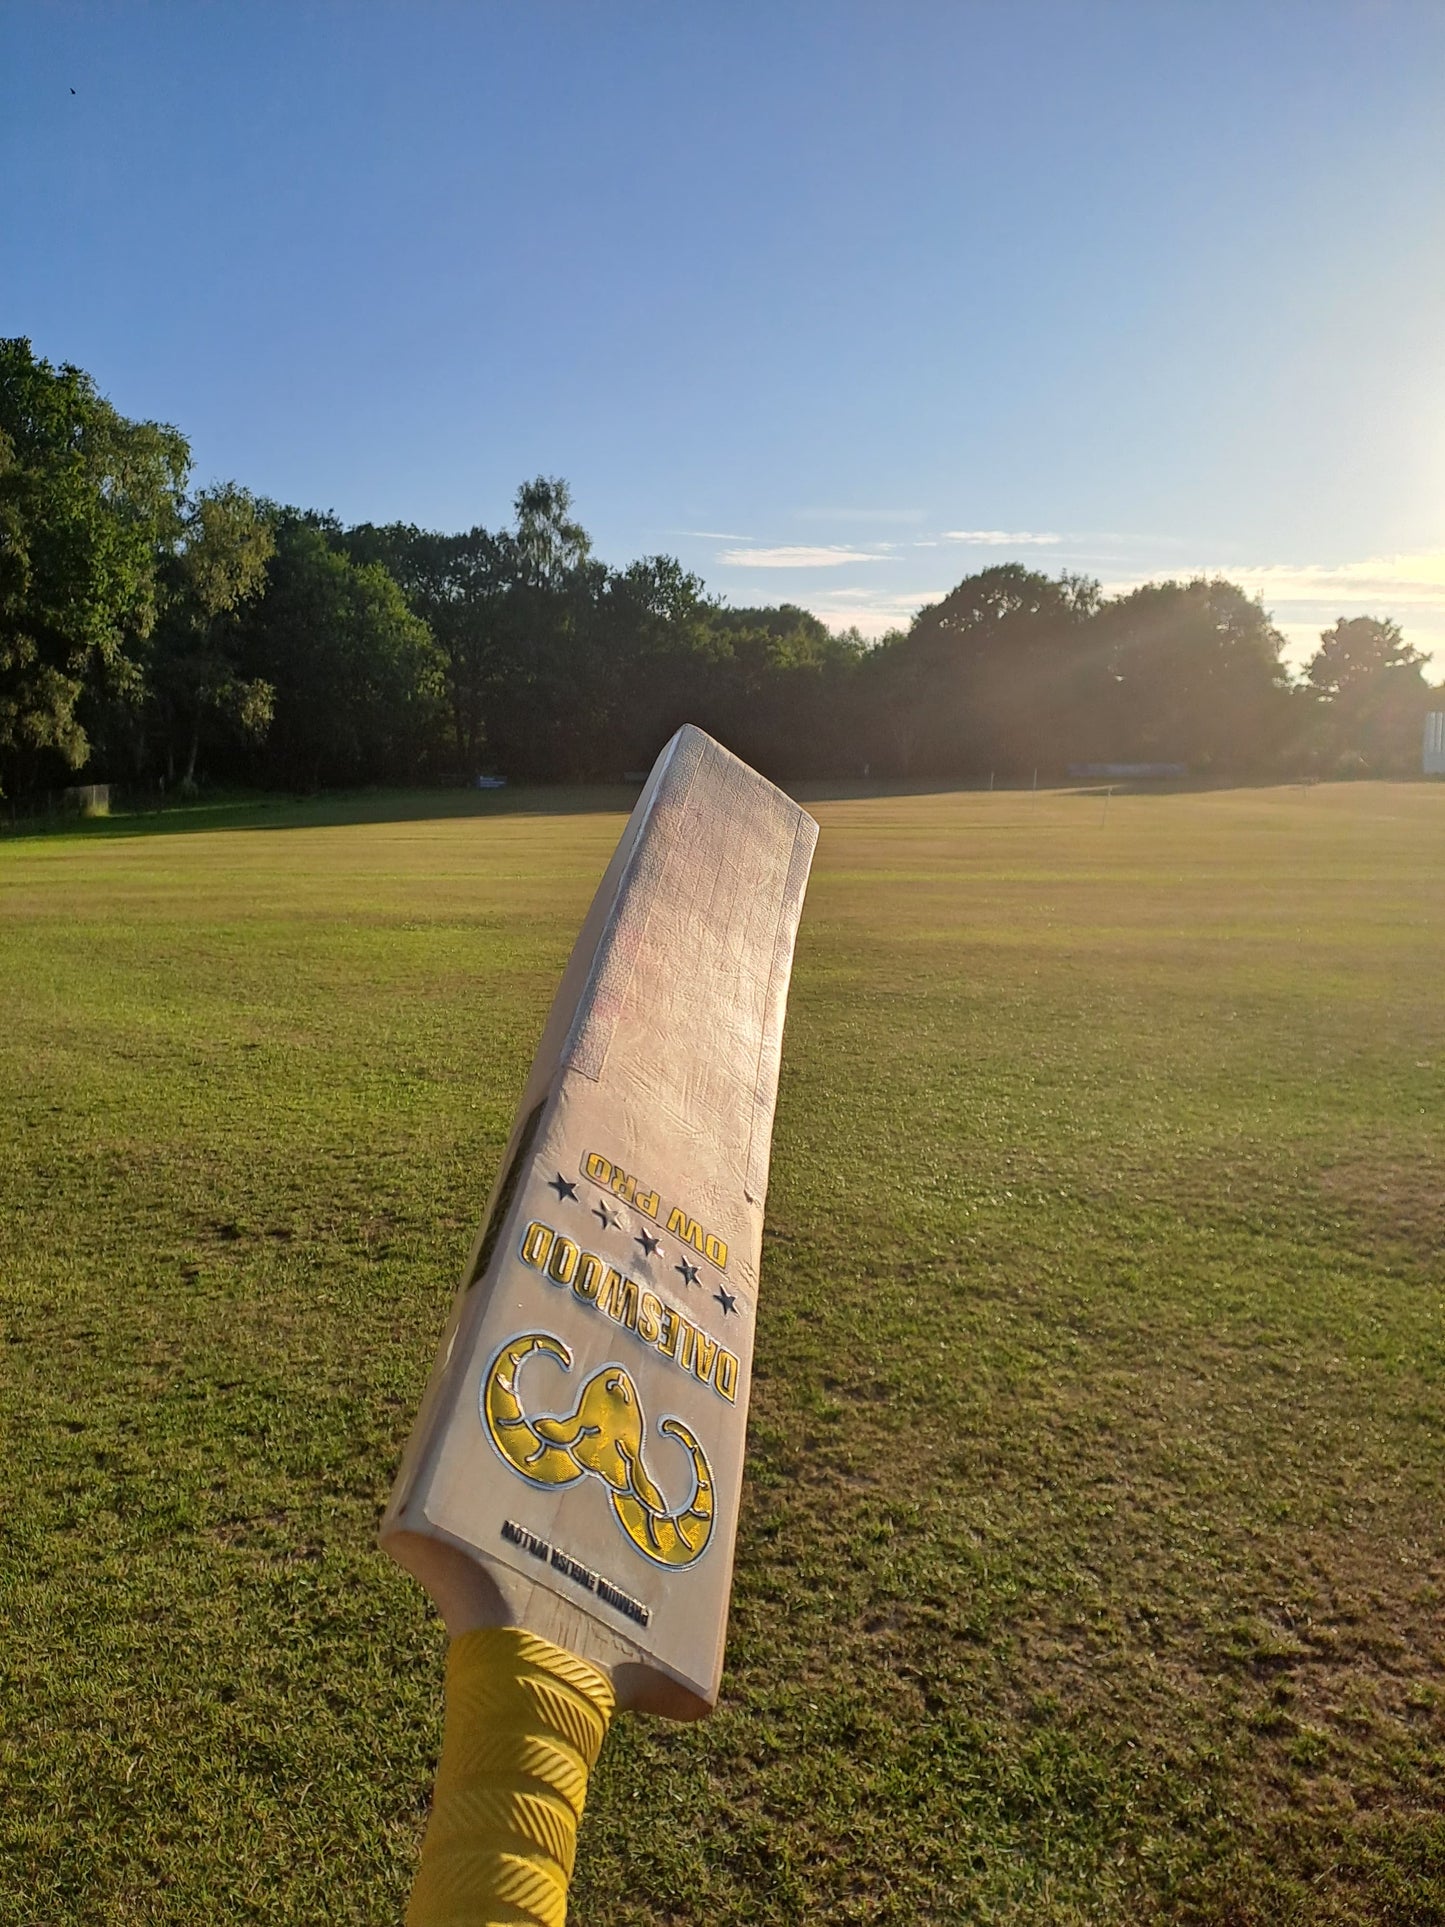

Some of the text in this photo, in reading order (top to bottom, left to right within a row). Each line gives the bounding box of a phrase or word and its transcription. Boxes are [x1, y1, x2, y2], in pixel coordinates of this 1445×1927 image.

[586, 1152, 728, 1269] DW PRO
[520, 1219, 740, 1405] DALESWOOD
[501, 1519, 551, 1563] WILLOW
[550, 1548, 599, 1592] ENGLISH
